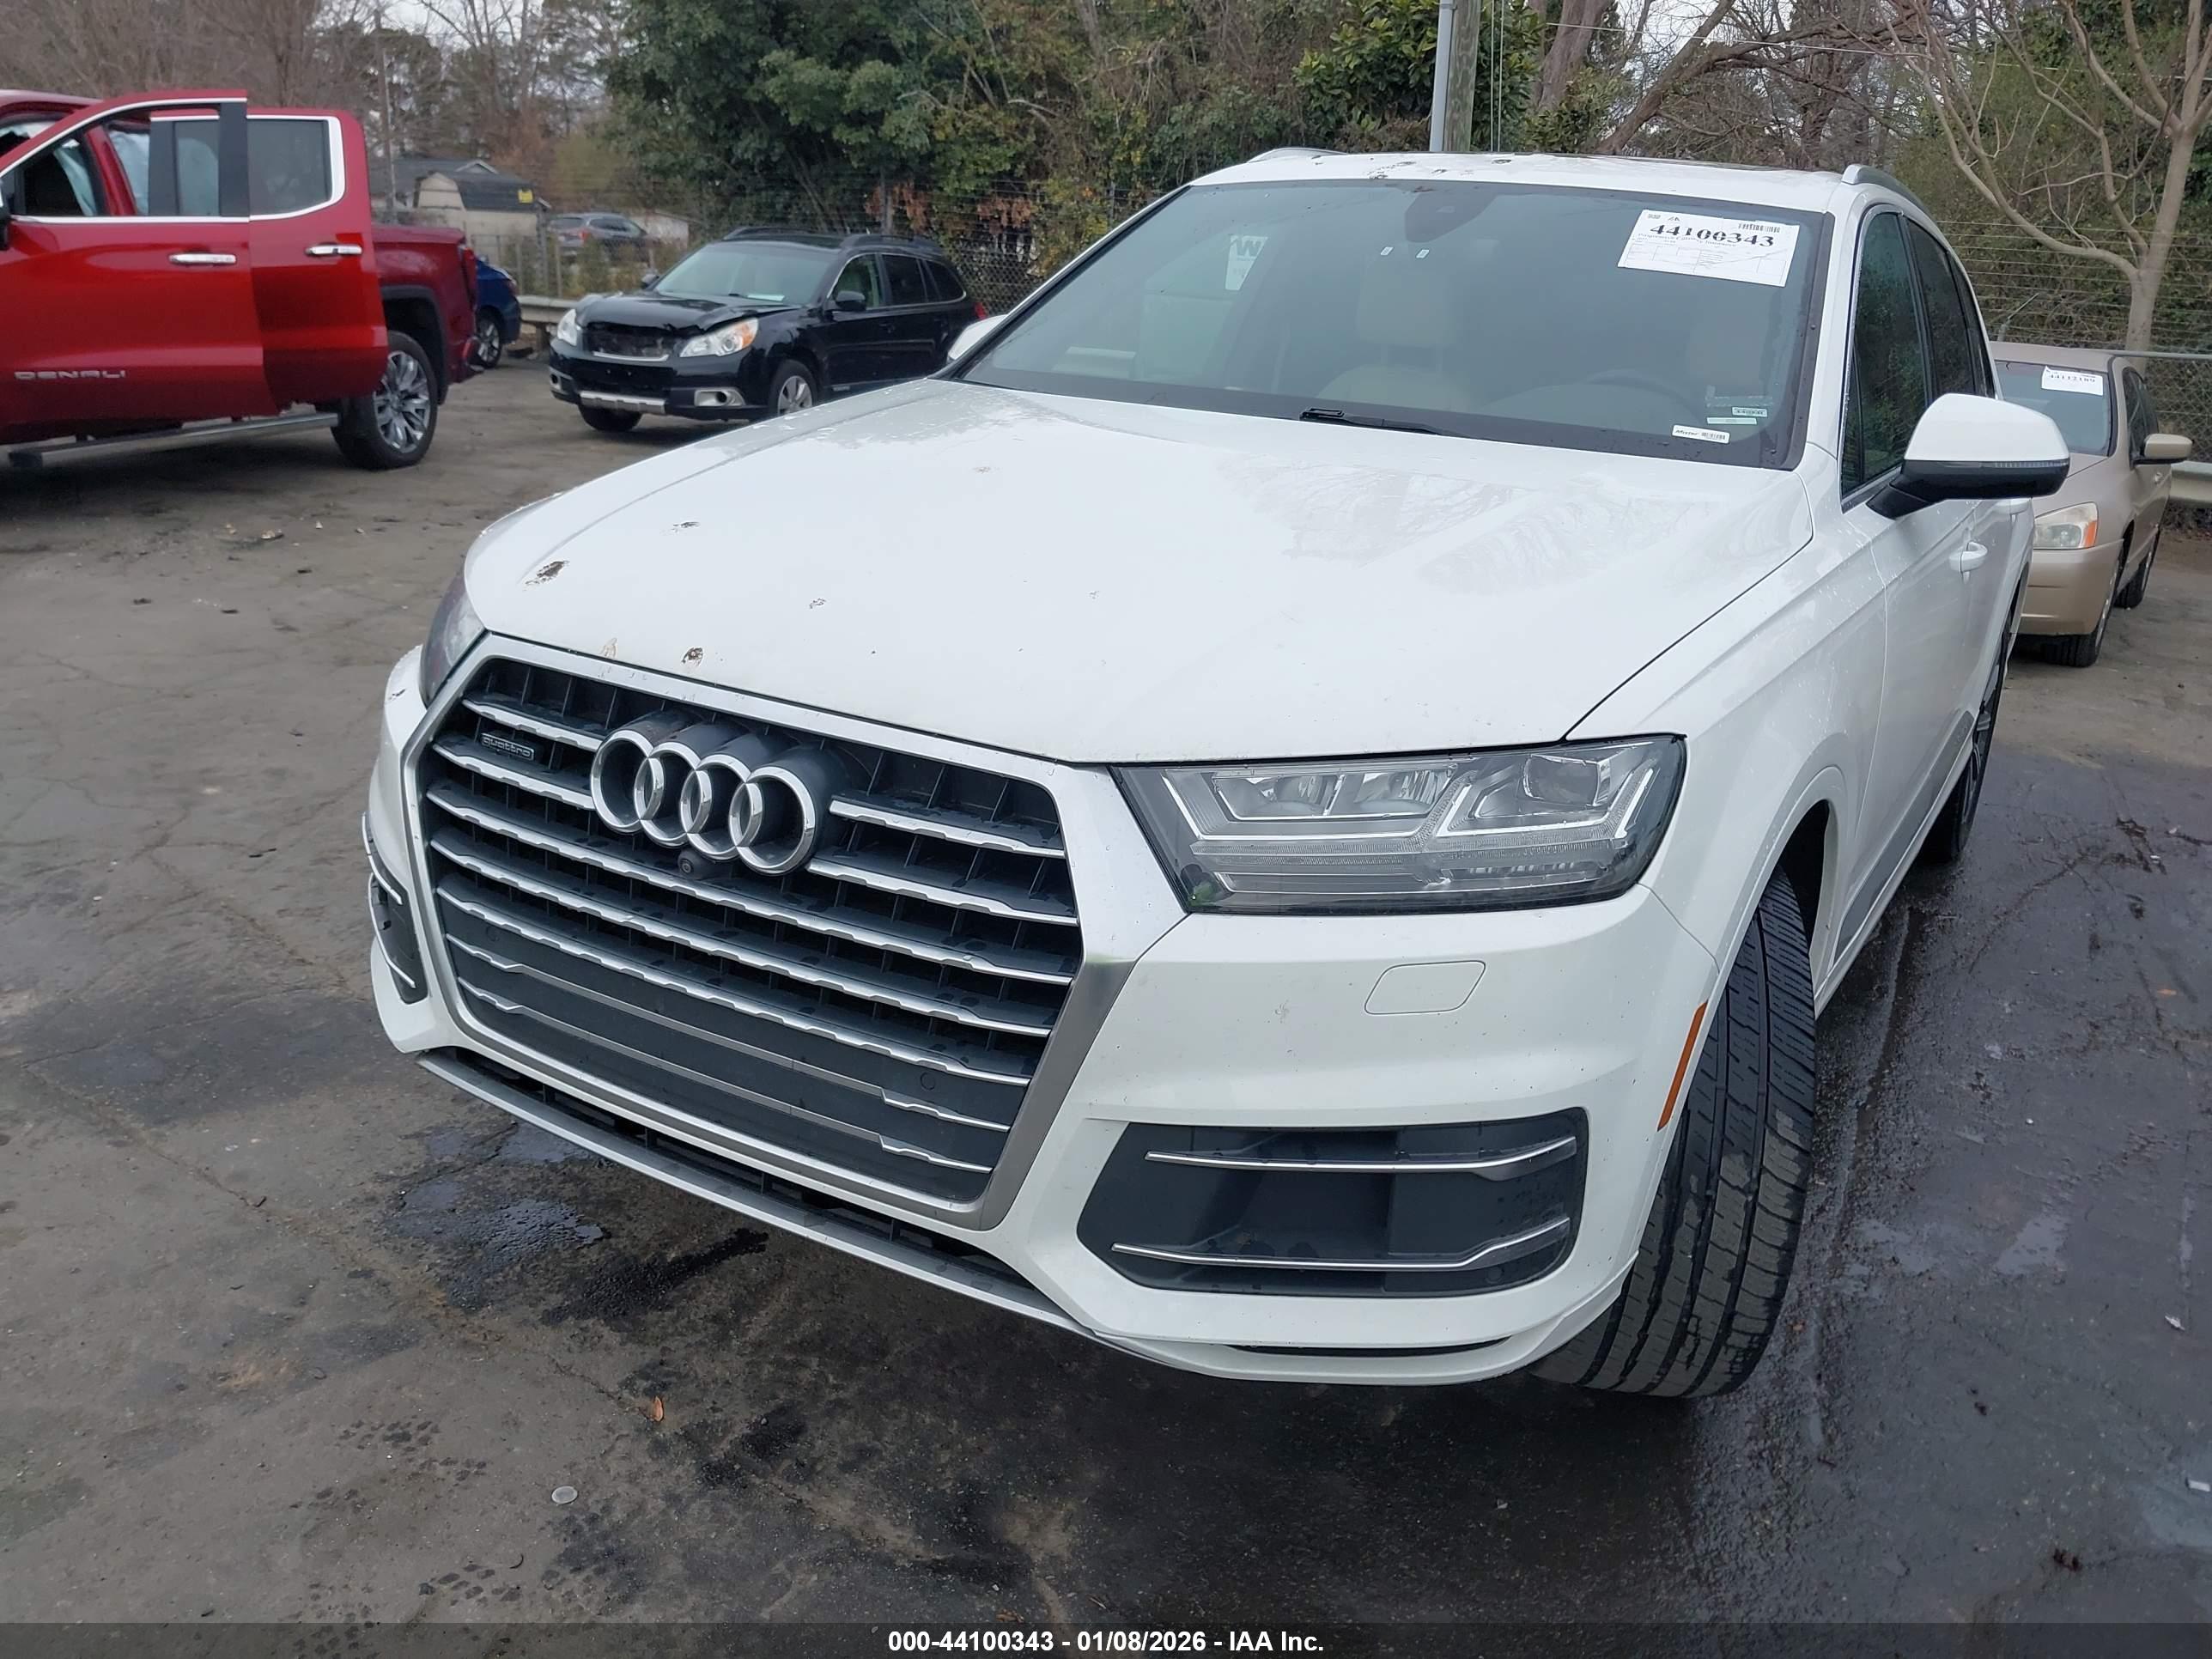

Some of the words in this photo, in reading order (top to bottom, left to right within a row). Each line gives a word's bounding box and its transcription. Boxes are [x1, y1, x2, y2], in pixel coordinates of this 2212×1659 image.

[1650, 224, 1774, 246] 44100343
[15, 370, 126, 380] DENALI
[483, 737, 531, 757] quattro
